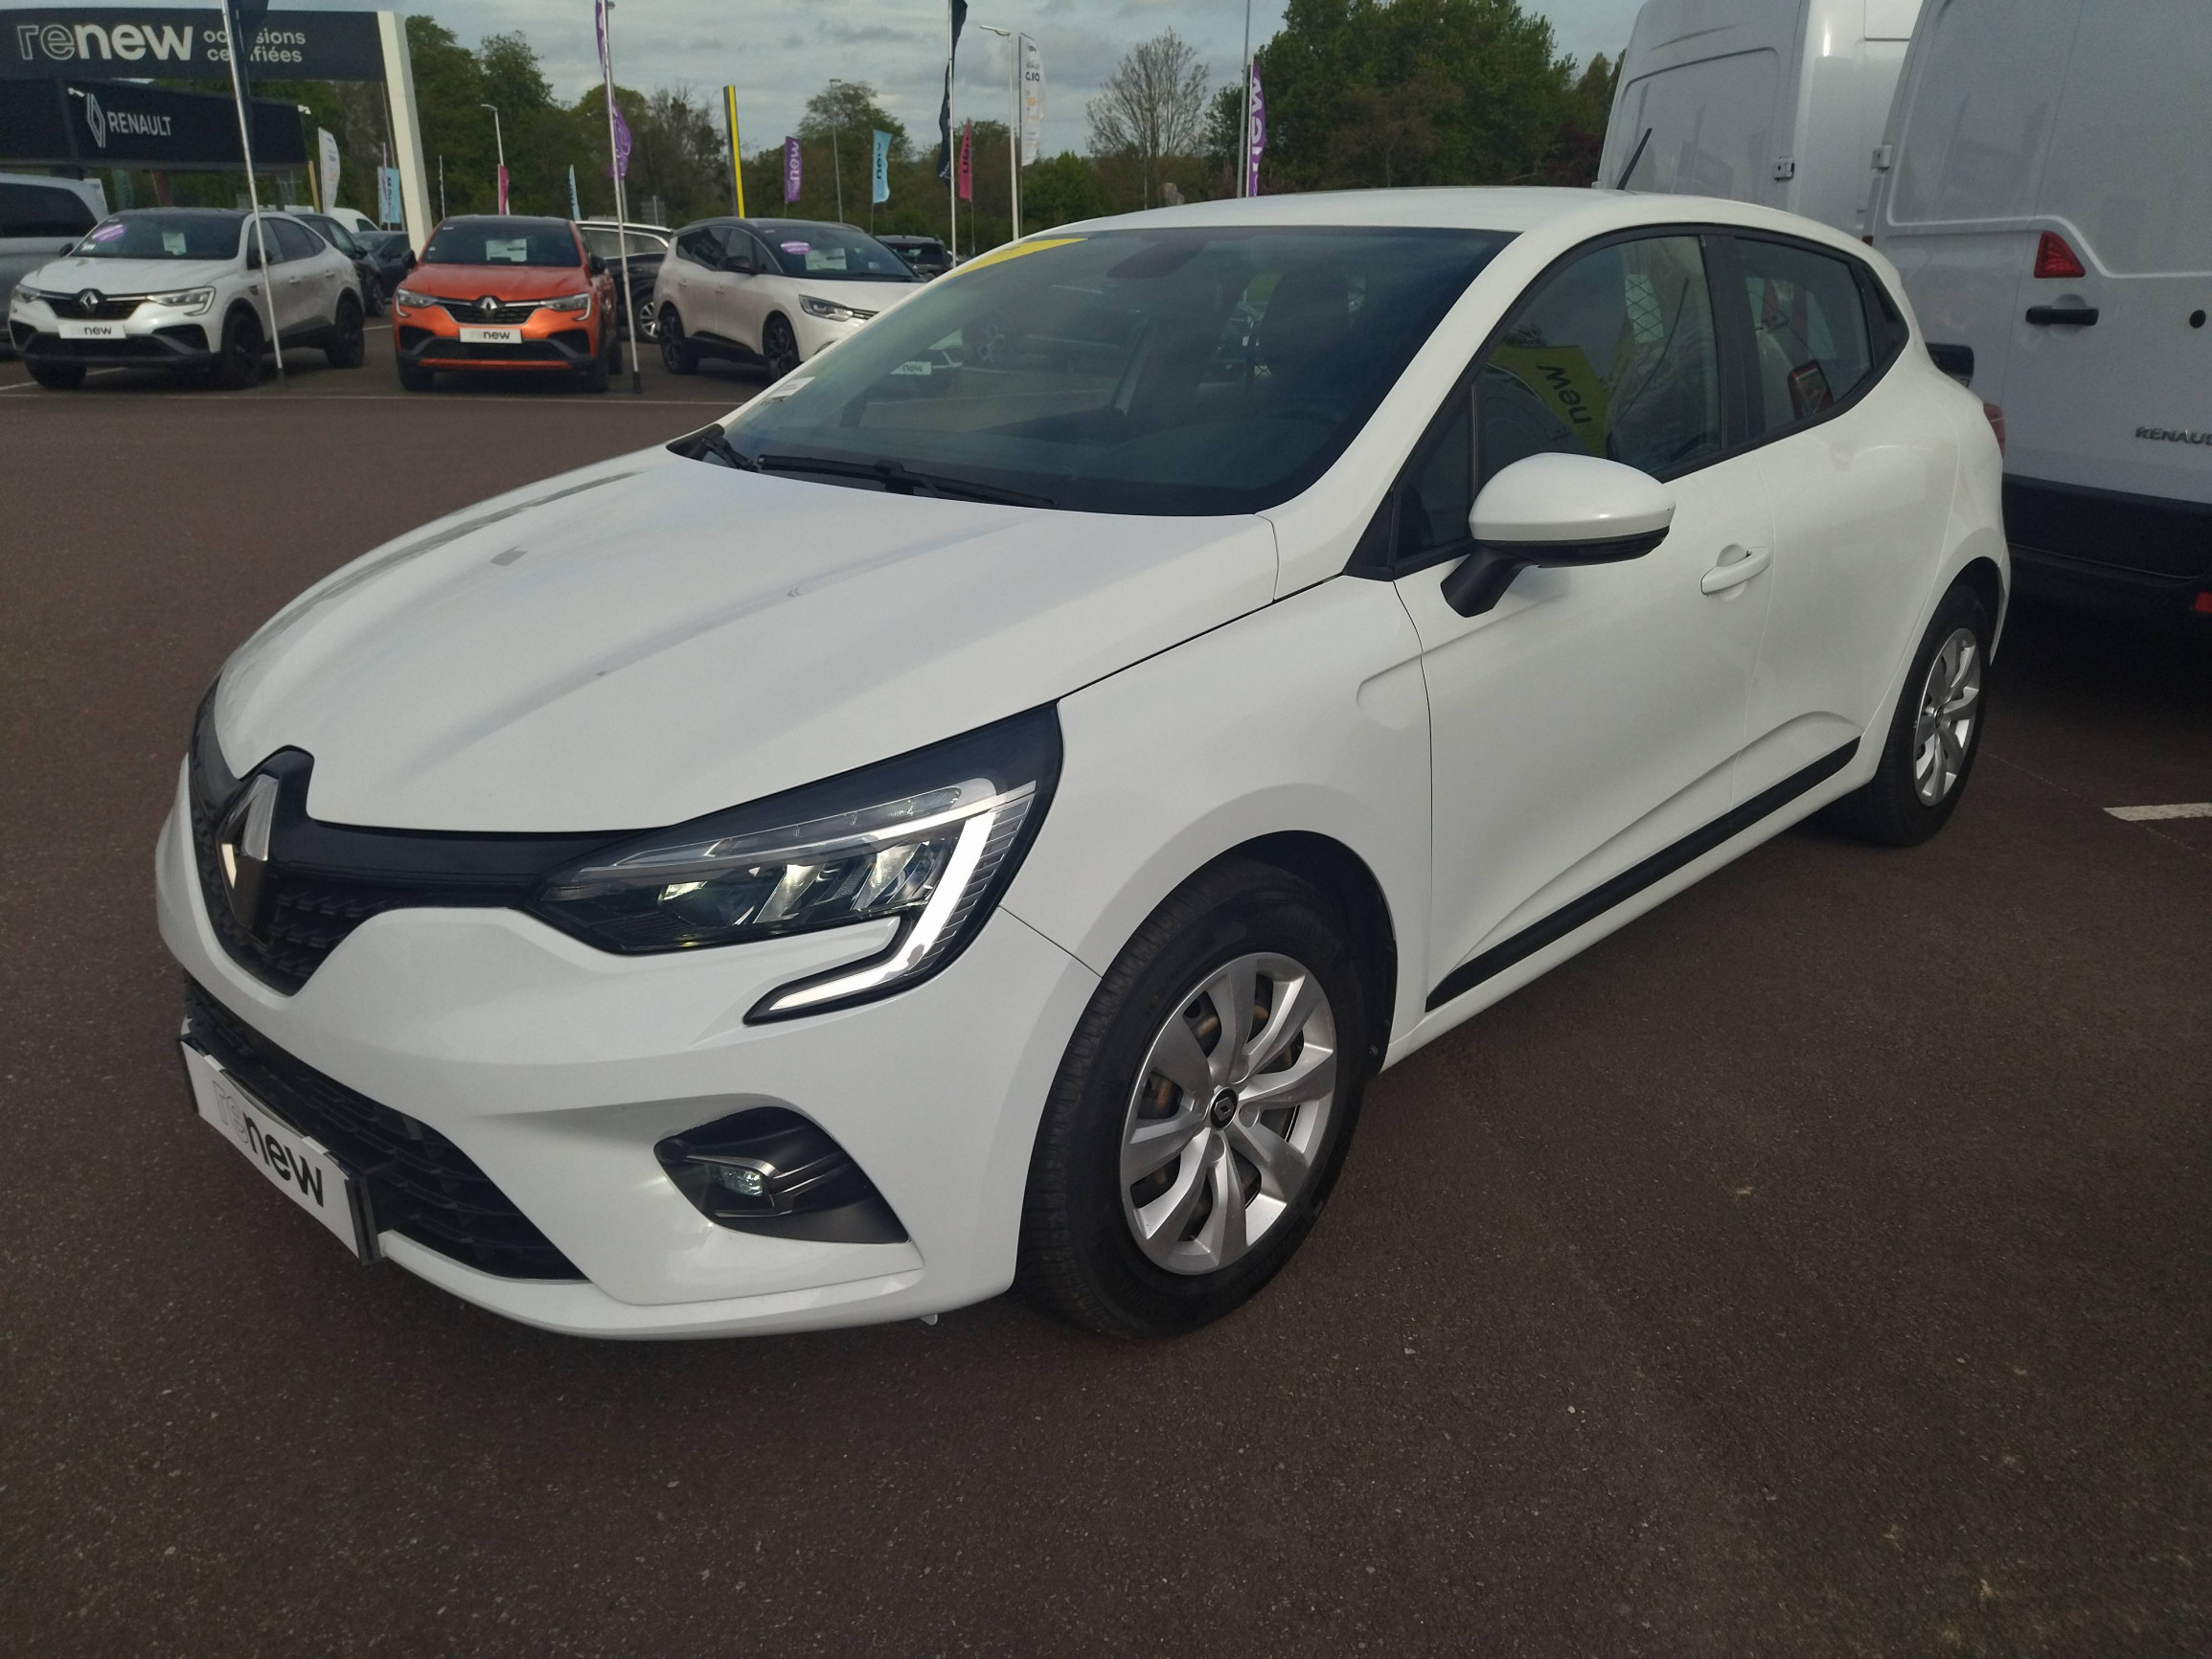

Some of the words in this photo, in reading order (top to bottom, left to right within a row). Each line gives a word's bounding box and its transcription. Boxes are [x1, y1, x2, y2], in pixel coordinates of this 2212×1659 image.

[16, 24, 193, 61] renew
[203, 28, 306, 45] ocsions
[109, 110, 171, 137] RENAULT
